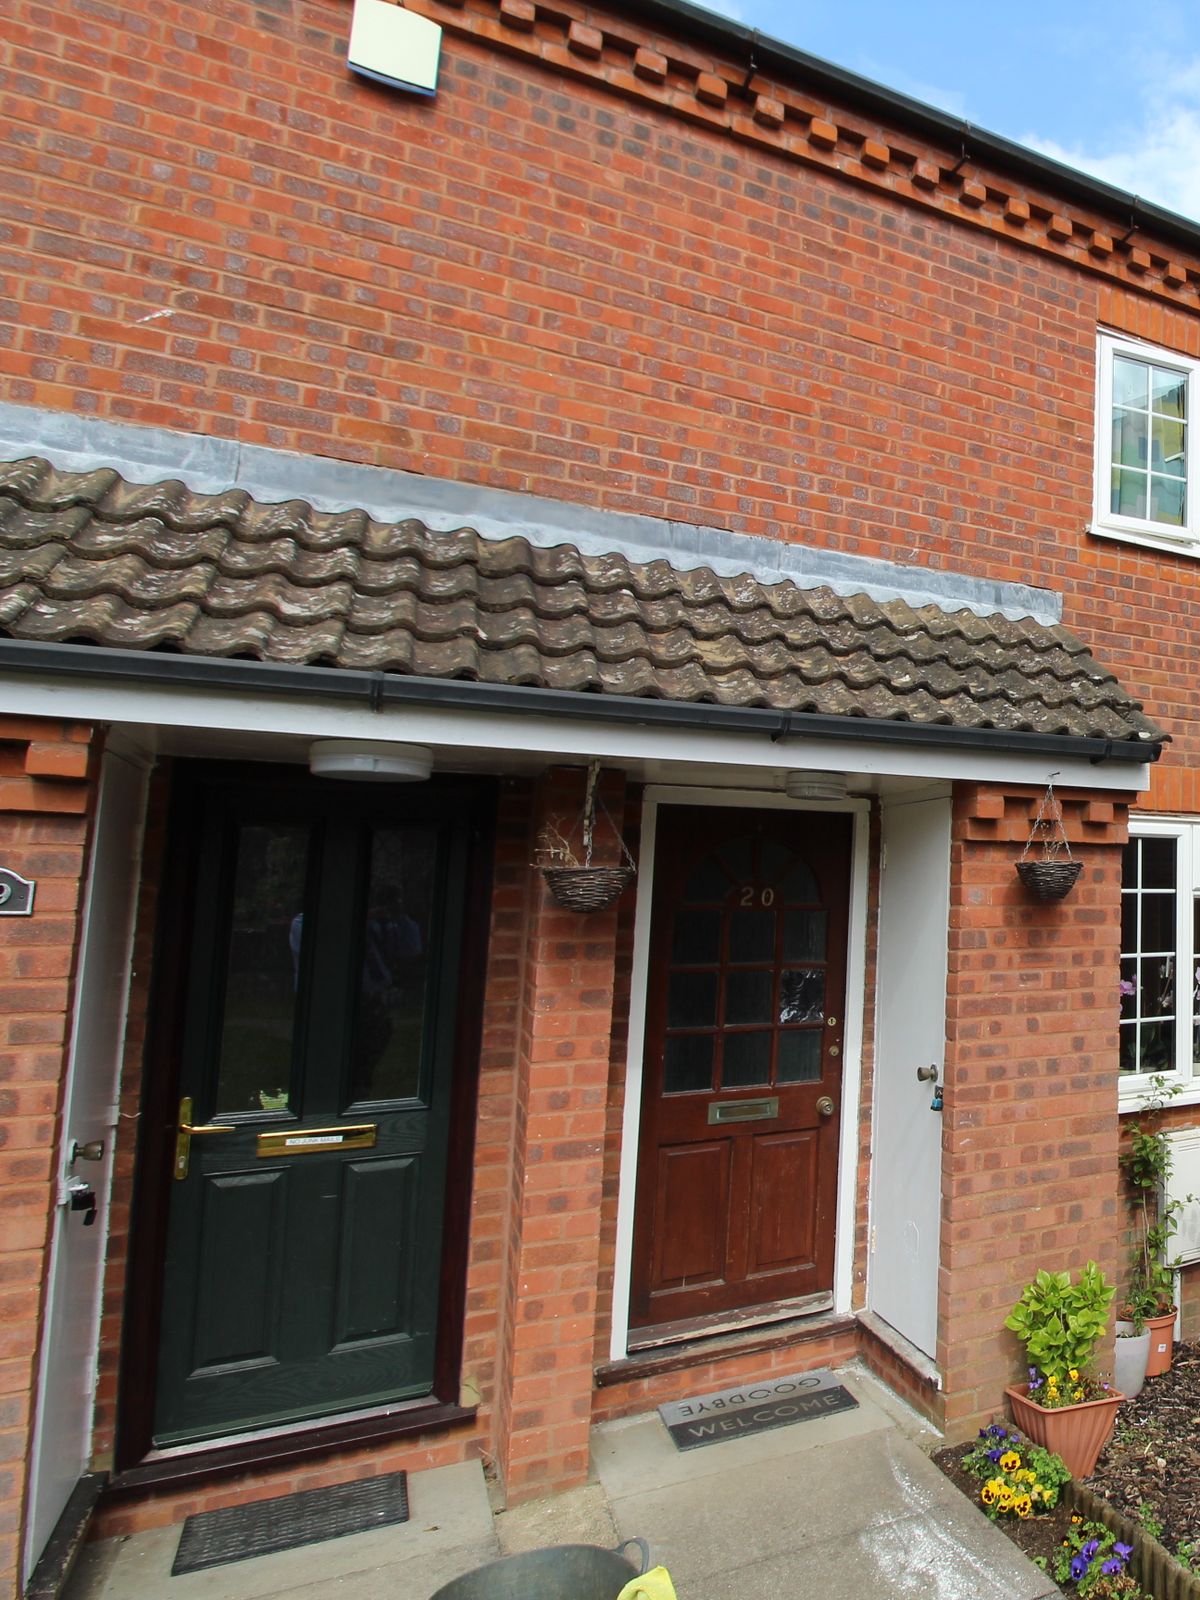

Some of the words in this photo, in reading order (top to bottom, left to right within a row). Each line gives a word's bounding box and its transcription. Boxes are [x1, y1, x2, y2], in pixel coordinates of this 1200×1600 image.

[740, 886, 775, 906] 20
[679, 1377, 821, 1417] GOODBYE
[688, 1394, 840, 1437] WELCOME
